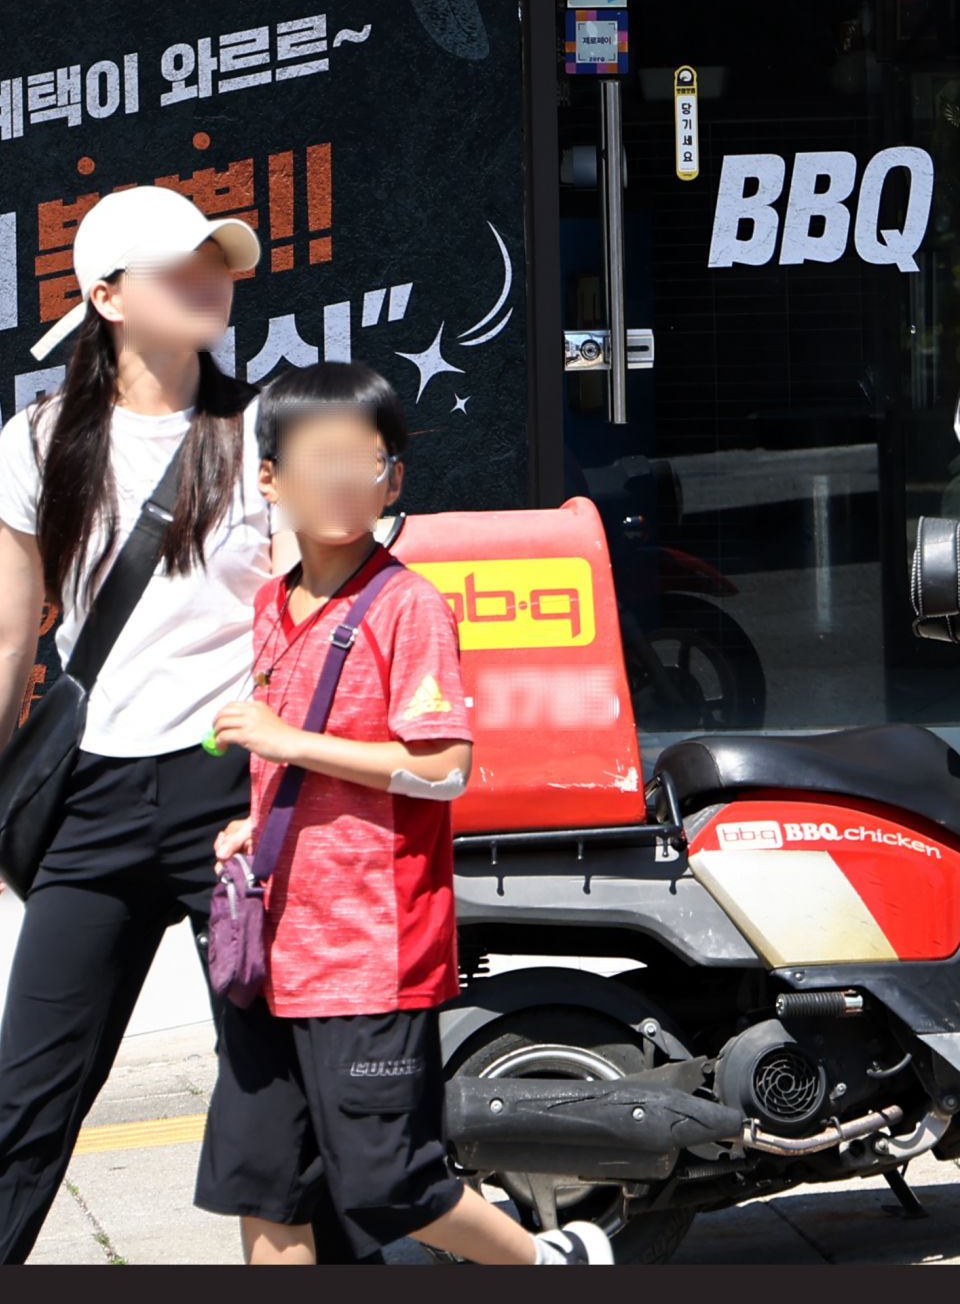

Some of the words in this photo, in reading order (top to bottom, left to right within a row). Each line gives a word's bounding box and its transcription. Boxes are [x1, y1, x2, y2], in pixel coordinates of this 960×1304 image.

[159, 13, 373, 107] 와르르~
[582, 36, 612, 45] 제로페이
[681, 102, 693, 162] 당기세요
[708, 146, 935, 273] BBQ
[783, 823, 843, 841] BBQ
[843, 827, 942, 859] chicken
